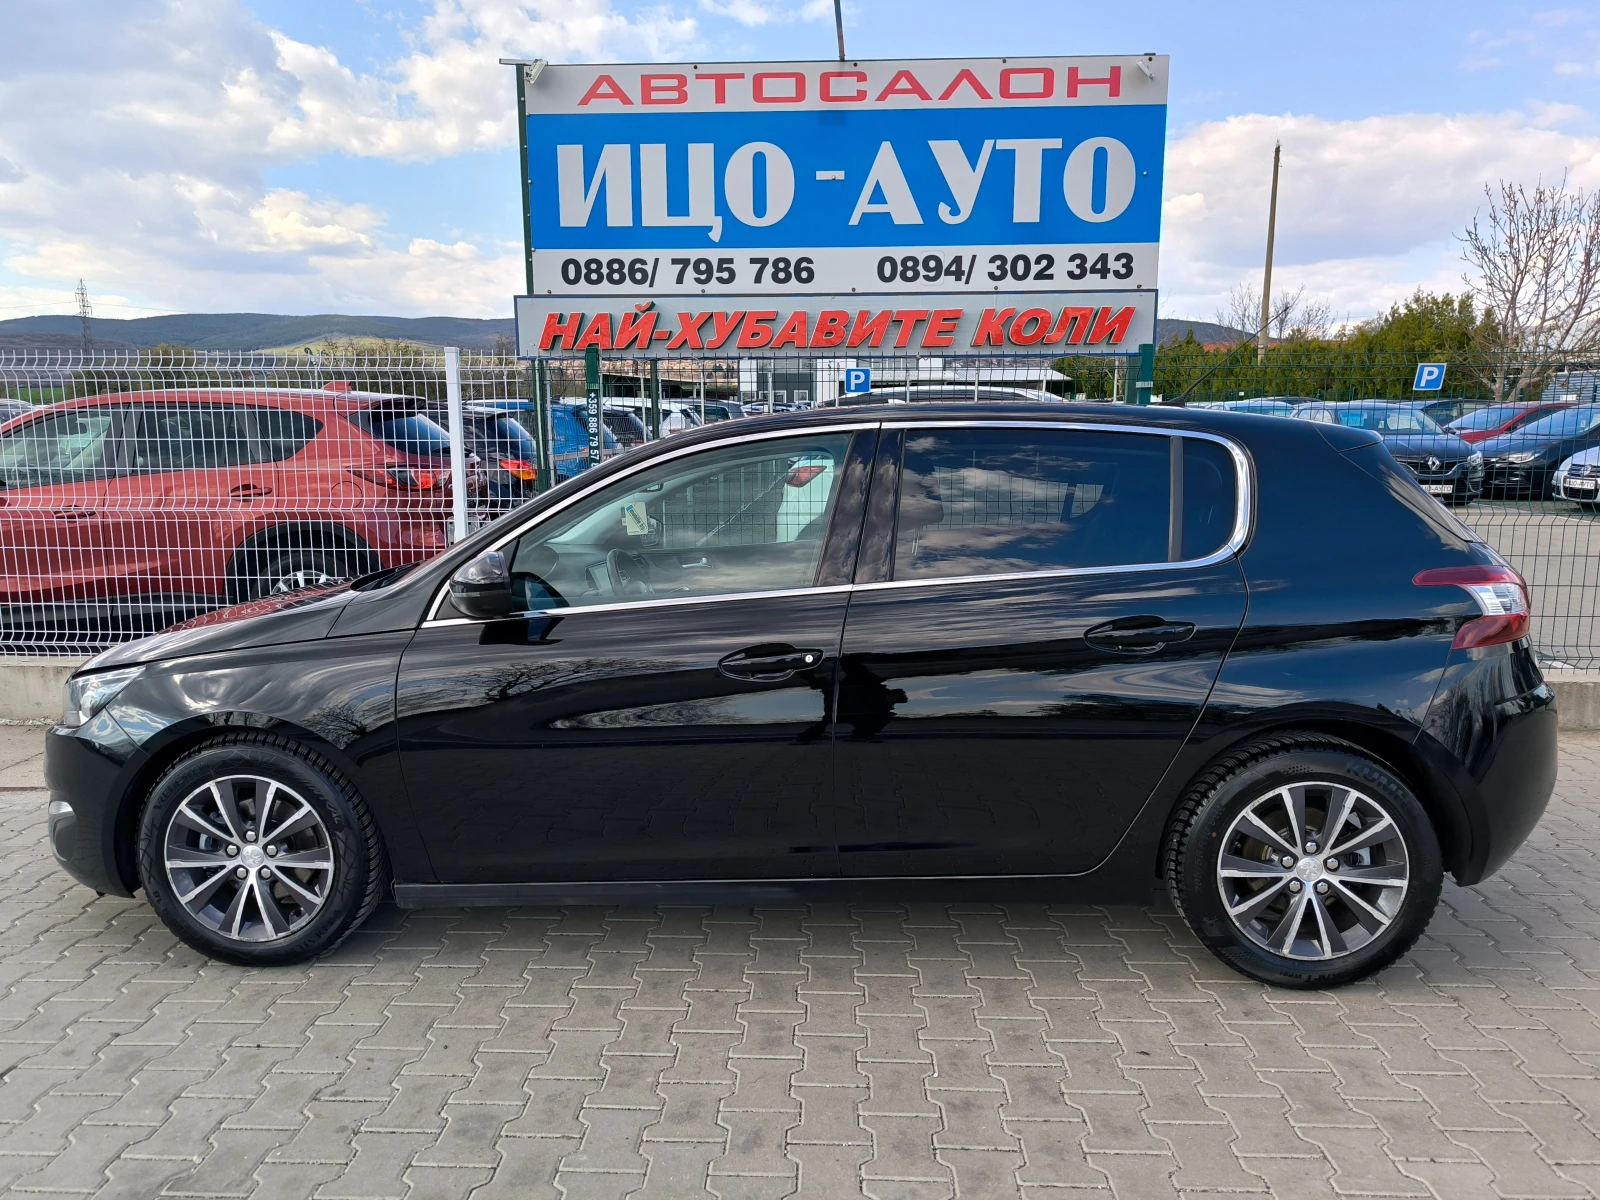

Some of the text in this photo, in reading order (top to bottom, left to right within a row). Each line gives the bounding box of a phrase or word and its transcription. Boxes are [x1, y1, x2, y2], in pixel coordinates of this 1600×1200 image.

[578, 66, 1122, 106] АВТОСАЛОН
[558, 143, 794, 242] ИЦО
[562, 257, 815, 288] 0886/ 795 786
[877, 252, 1134, 285] 0894/ 302 343
[538, 302, 1136, 350] НАЙ-ХУБАВИТЕ КОЛИ
[850, 372, 865, 390] P
[1420, 366, 1439, 387] P
[588, 392, 598, 415] +359
[588, 417, 598, 433] 886
[589, 436, 599, 447] 79
[590, 449, 600, 460] 57
